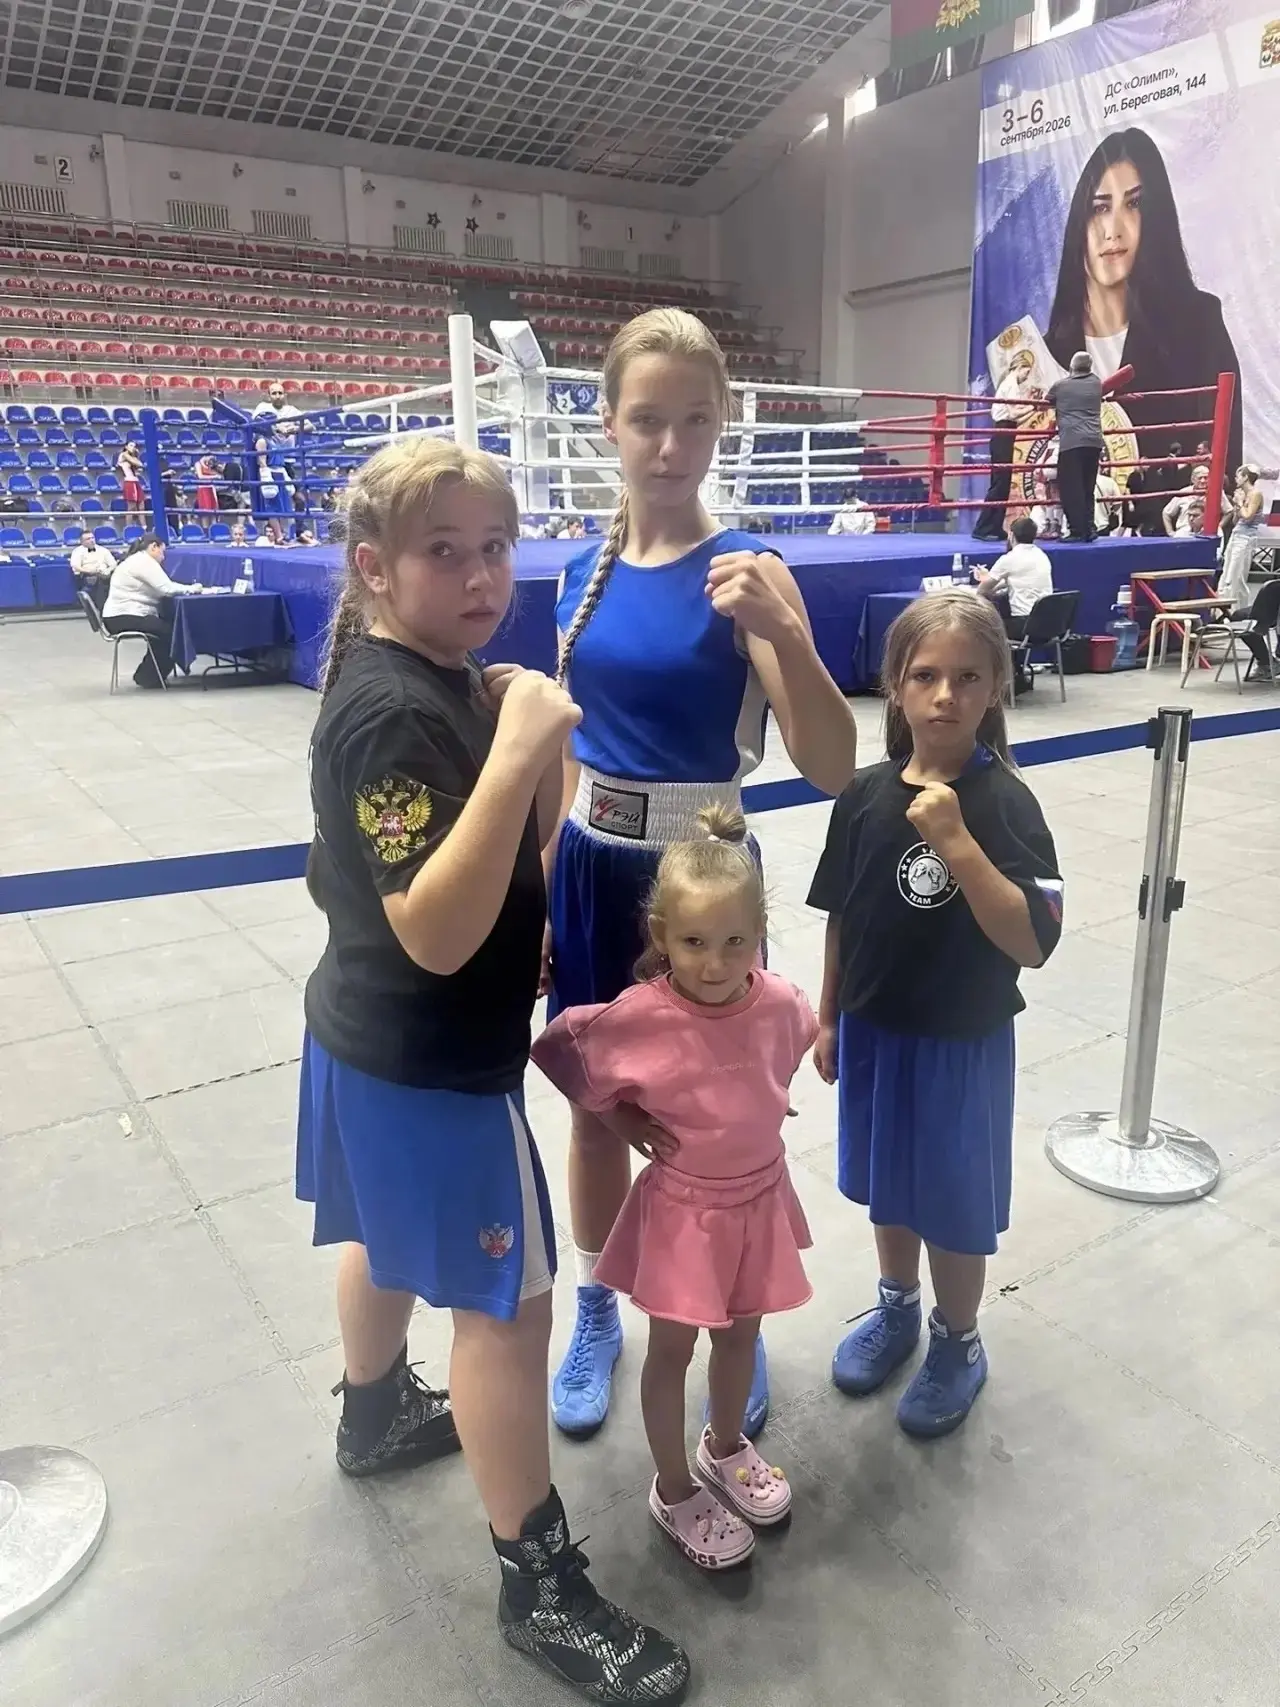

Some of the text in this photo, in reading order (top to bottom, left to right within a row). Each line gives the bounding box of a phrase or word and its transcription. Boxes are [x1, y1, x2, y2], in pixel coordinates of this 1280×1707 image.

[1103, 73, 1207, 118] ул. Береговая, 144
[1105, 67, 1179, 100] ДС «Олимп»,
[1000, 115, 1071, 146] сентября 2026
[58, 158, 70, 176] 2
[562, 398, 569, 408] 2
[909, 892, 932, 904] TEAM
